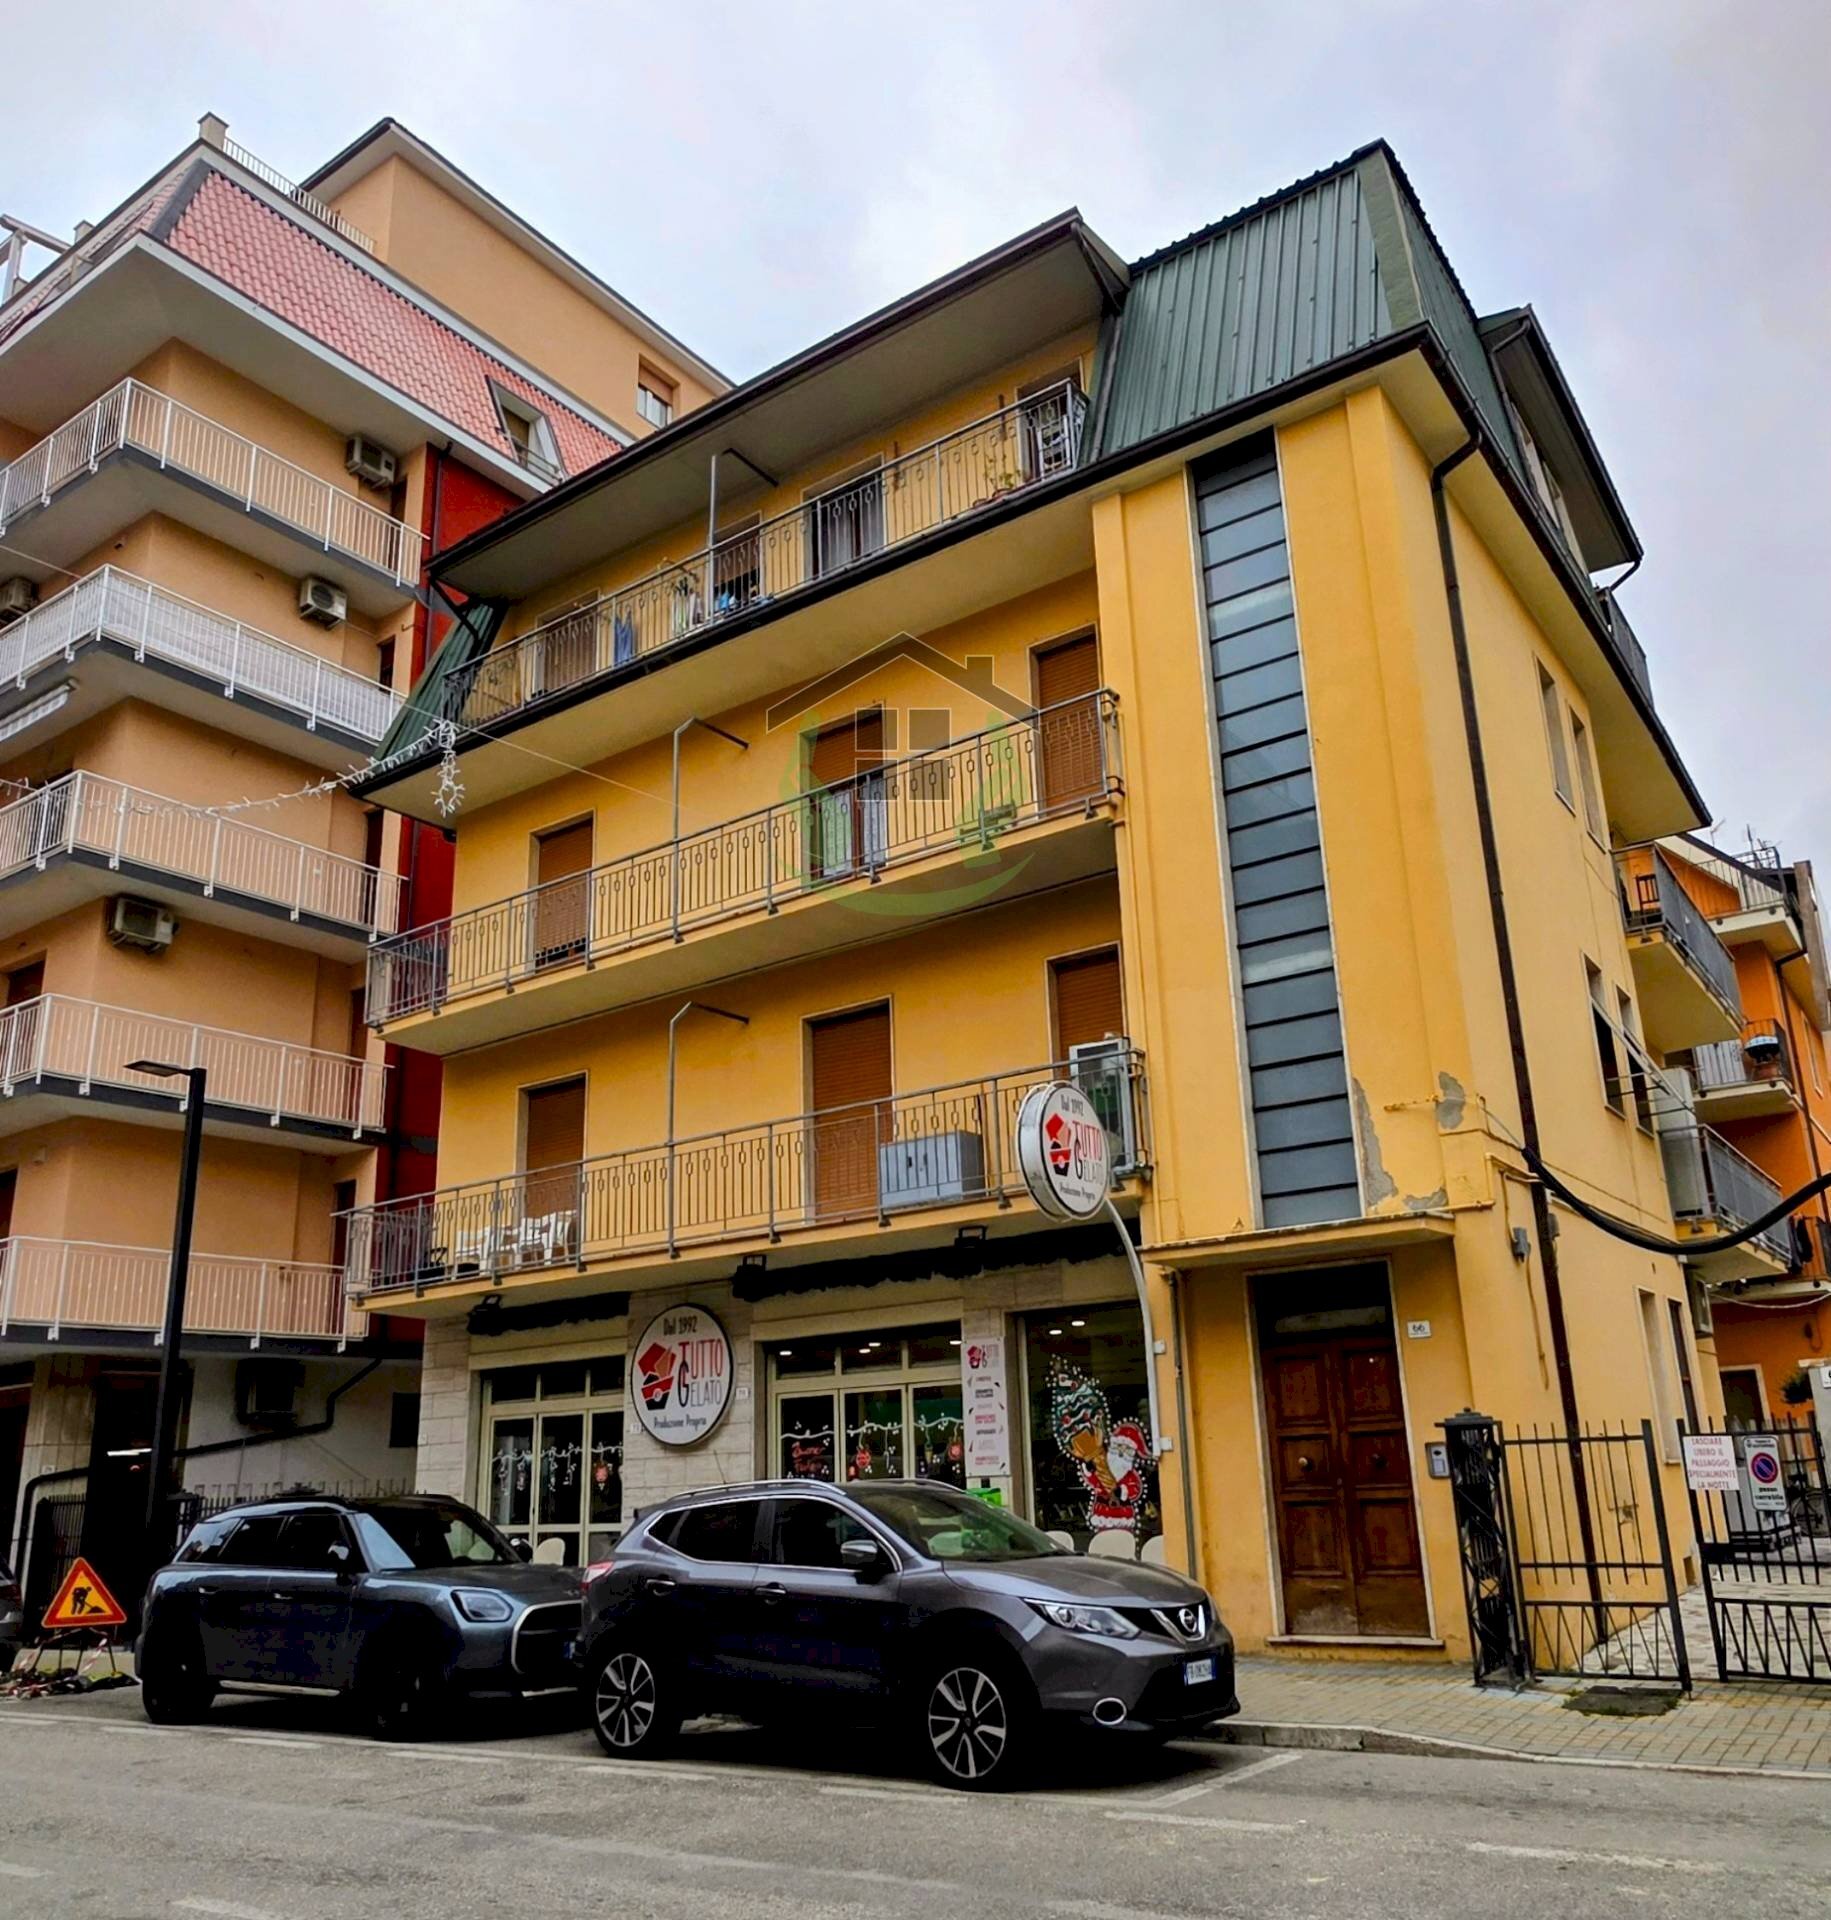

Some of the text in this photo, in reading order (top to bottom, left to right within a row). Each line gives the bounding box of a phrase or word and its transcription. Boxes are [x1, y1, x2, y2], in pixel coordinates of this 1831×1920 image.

[1073, 1121, 1102, 1162] TUTTO
[664, 1316, 697, 1335] Dal 1992
[678, 1338, 723, 1380] TUTTO
[678, 1361, 722, 1407] GELATO
[1694, 1448, 1716, 1456] LIBERO
[1691, 1459, 1729, 1467] PASSAGGIO
[1688, 1470, 1736, 1478] SPECIALMENTE
[1697, 1480, 1729, 1489] LA NOTTE
